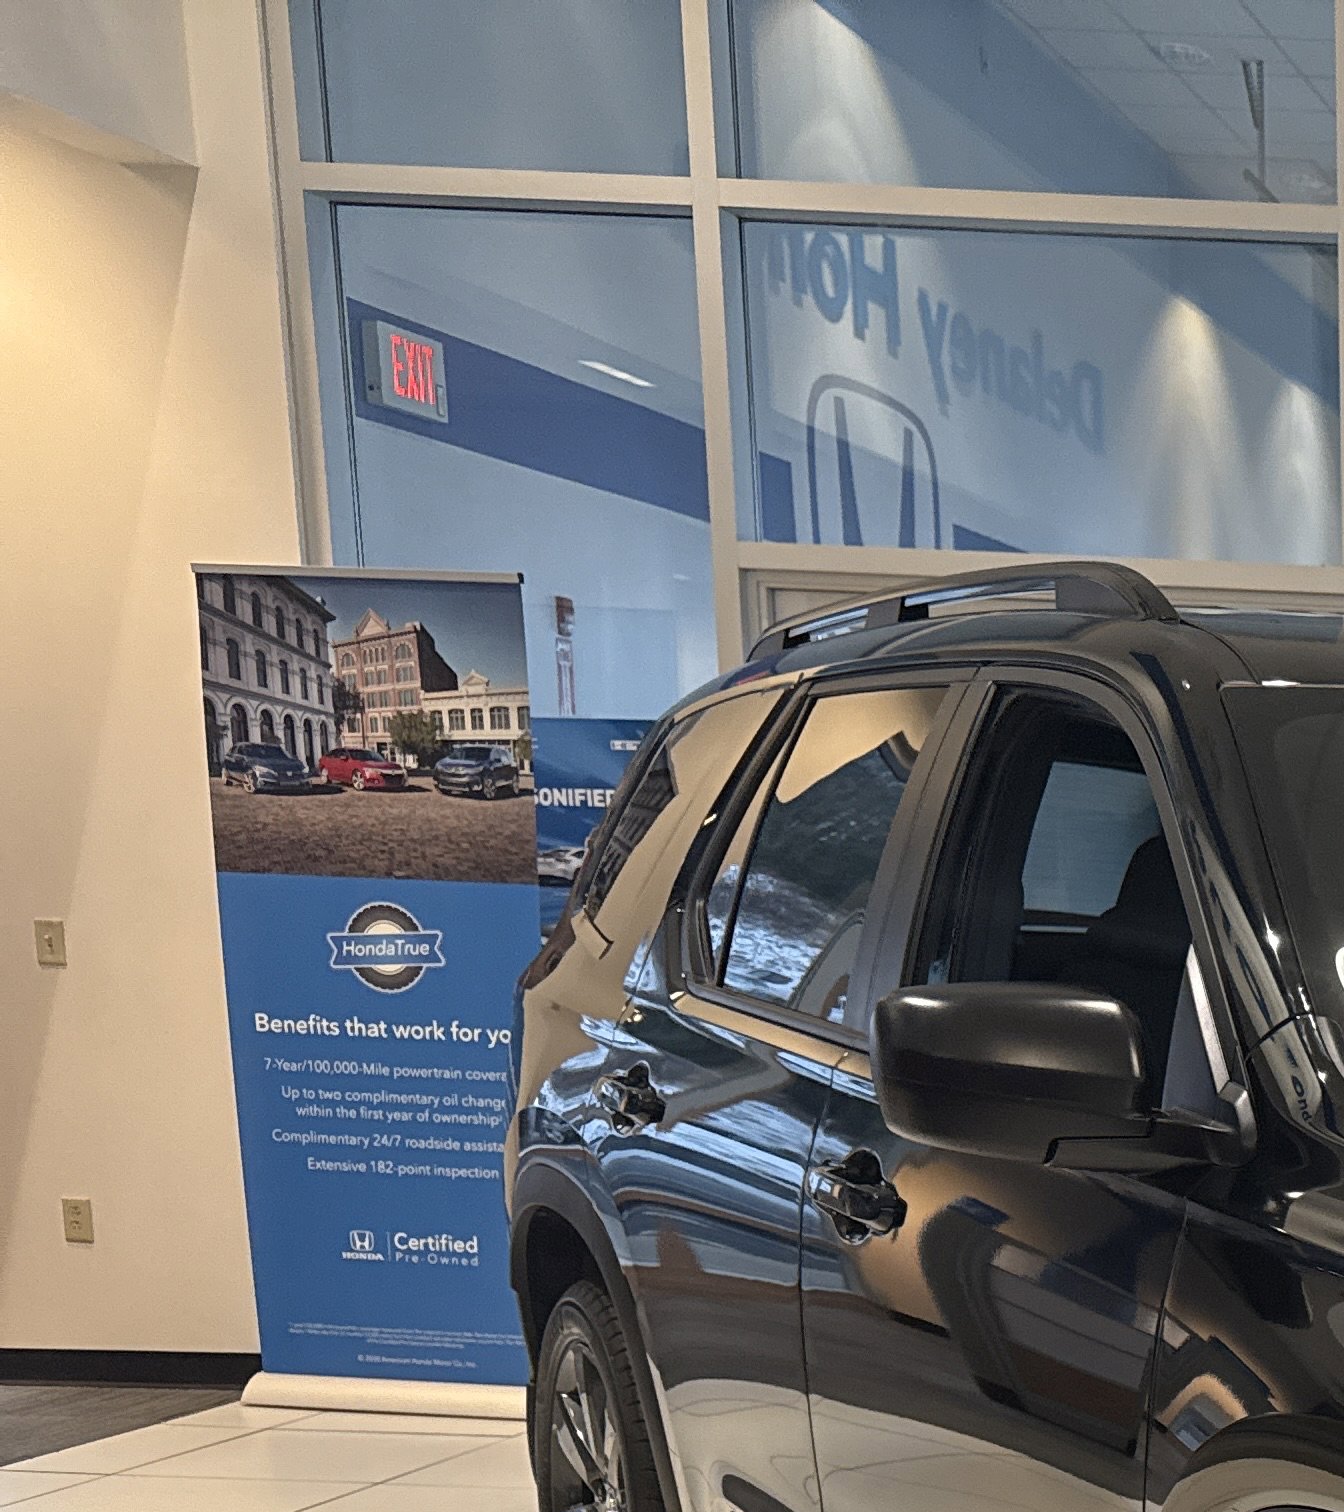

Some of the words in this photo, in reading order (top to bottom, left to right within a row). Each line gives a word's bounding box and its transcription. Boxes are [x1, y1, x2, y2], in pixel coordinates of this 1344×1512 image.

[391, 334, 437, 406] EXIT
[342, 939, 430, 957] HondaTrue
[254, 1012, 341, 1036] Benefits
[344, 1016, 388, 1038] that
[392, 1020, 446, 1041] work
[450, 1020, 482, 1042] for
[263, 1057, 391, 1077] 7-Year/100,000-Mile
[393, 1066, 463, 1080] powertrain
[281, 1086, 300, 1101] Up
[302, 1088, 316, 1099] to
[318, 1089, 342, 1101] two
[345, 1090, 440, 1108] complimentary
[442, 1094, 459, 1106] oil
[296, 1103, 333, 1118] within
[335, 1105, 357, 1119] the
[360, 1106, 384, 1120] first
[386, 1111, 413, 1124] year
[416, 1109, 430, 1121] of
[271, 1129, 370, 1149] Complimentary
[372, 1134, 402, 1147] 24/7
[405, 1136, 461, 1151] roadside
[307, 1157, 367, 1173] Extensive
[370, 1160, 431, 1177] 182-point
[433, 1164, 500, 1180] inspection
[393, 1231, 479, 1254] Certified
[341, 1251, 385, 1261] HONDA
[394, 1251, 479, 1267] Pre-Owned
